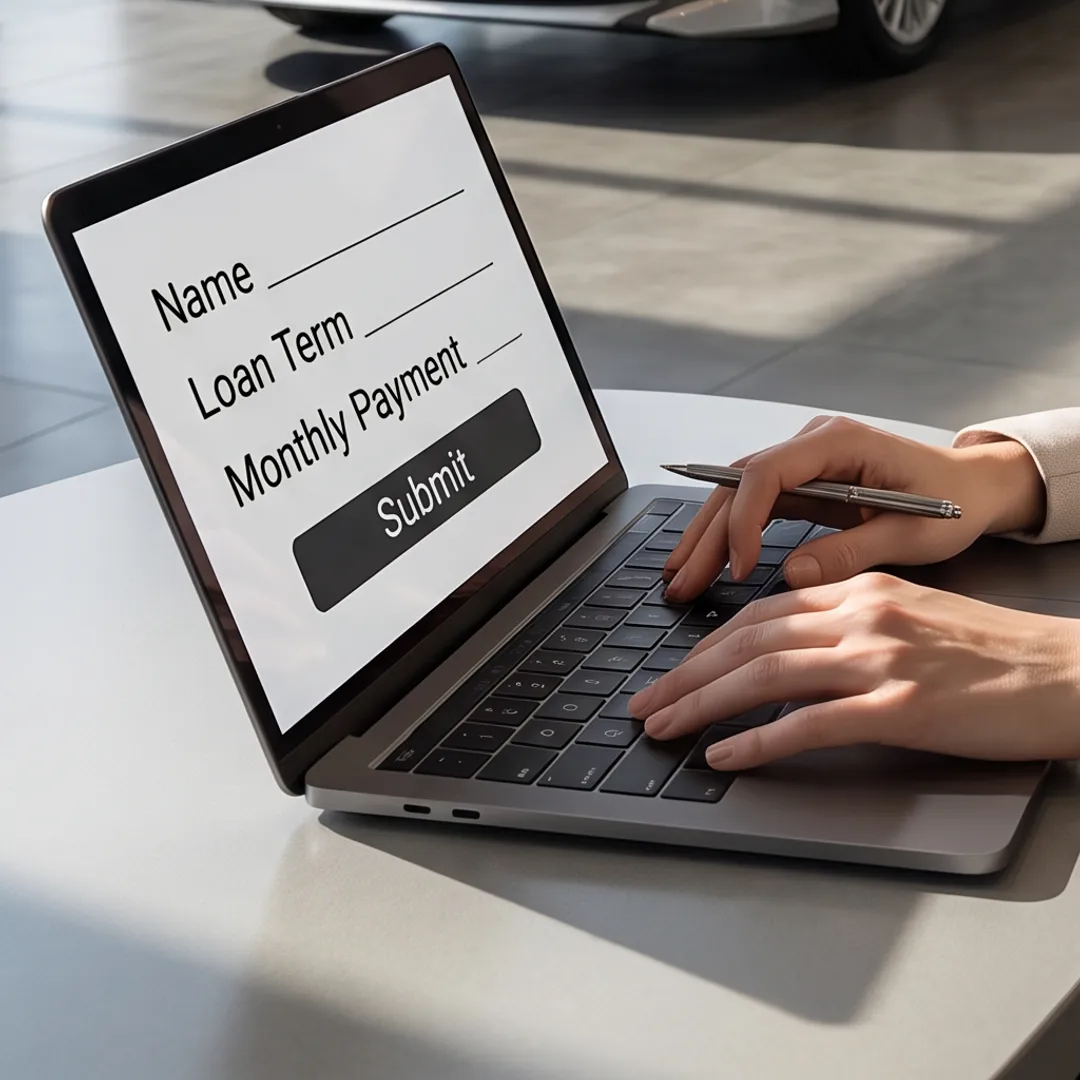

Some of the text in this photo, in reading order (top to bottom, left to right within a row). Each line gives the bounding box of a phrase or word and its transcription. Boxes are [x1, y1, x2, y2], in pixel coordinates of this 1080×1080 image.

[151, 262, 254, 332] Name
[187, 311, 354, 420] Loan Term
[223, 335, 468, 508] Monthly Payment
[376, 449, 476, 538] Submit
